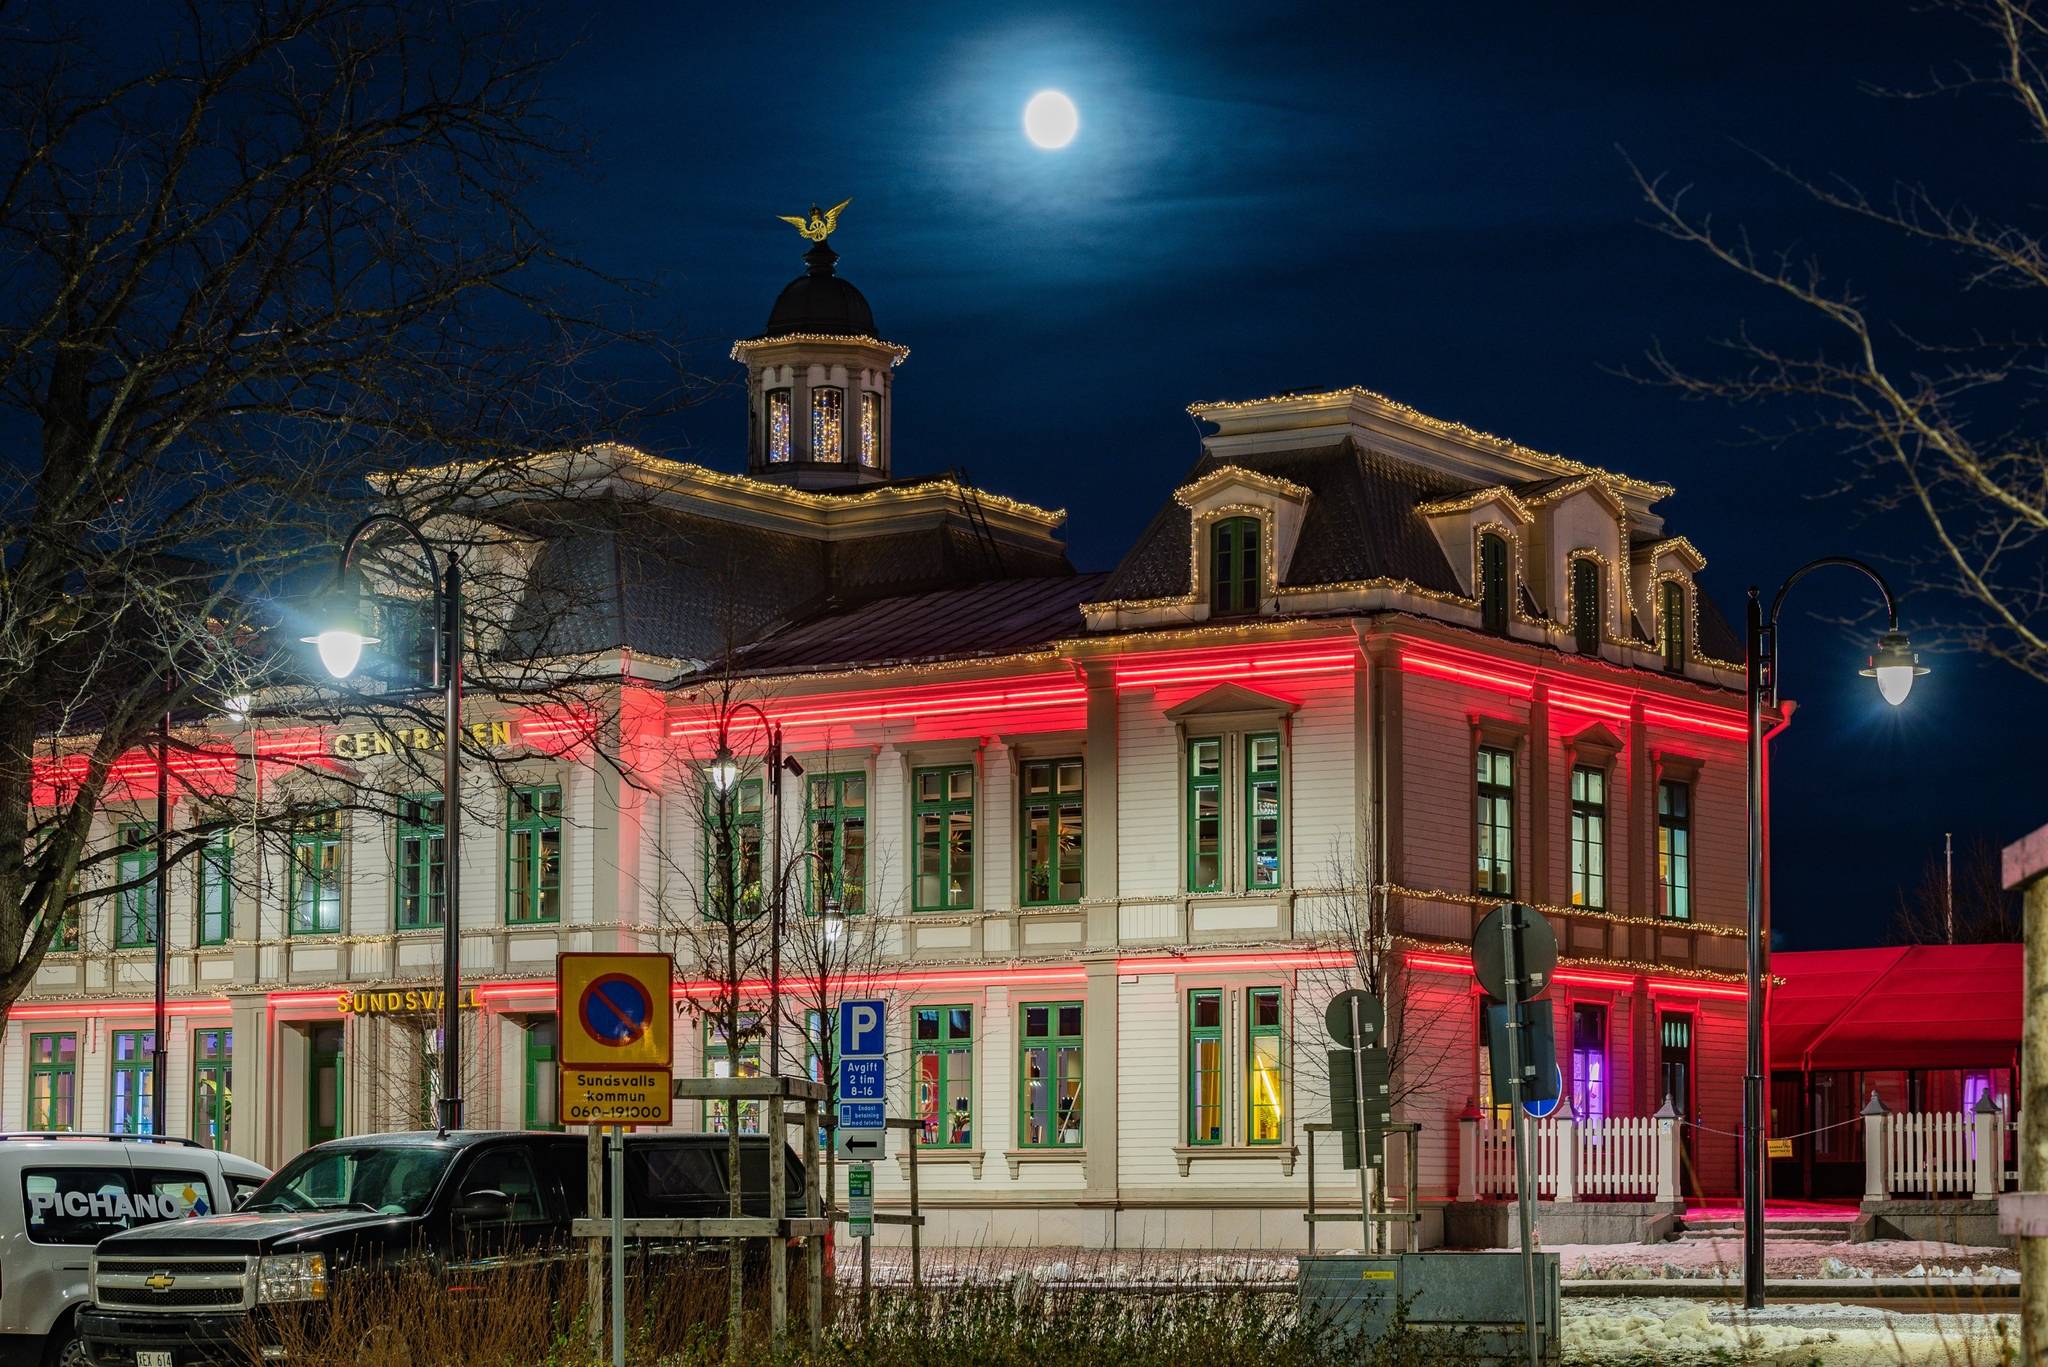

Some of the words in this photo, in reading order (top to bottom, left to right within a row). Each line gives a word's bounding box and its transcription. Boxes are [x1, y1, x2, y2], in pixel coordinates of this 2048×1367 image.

[334, 721, 512, 757] CENTREN
[852, 1006, 877, 1050] P
[848, 1062, 877, 1074] Avgift
[577, 1075, 655, 1087] Sundsvalls
[850, 1075, 856, 1084] 2
[860, 1074, 875, 1084] tim
[587, 1091, 645, 1102] kommun
[851, 1086, 873, 1096] 8-16
[571, 1106, 662, 1118] 060-191000
[31, 1191, 181, 1219] PICHANO
